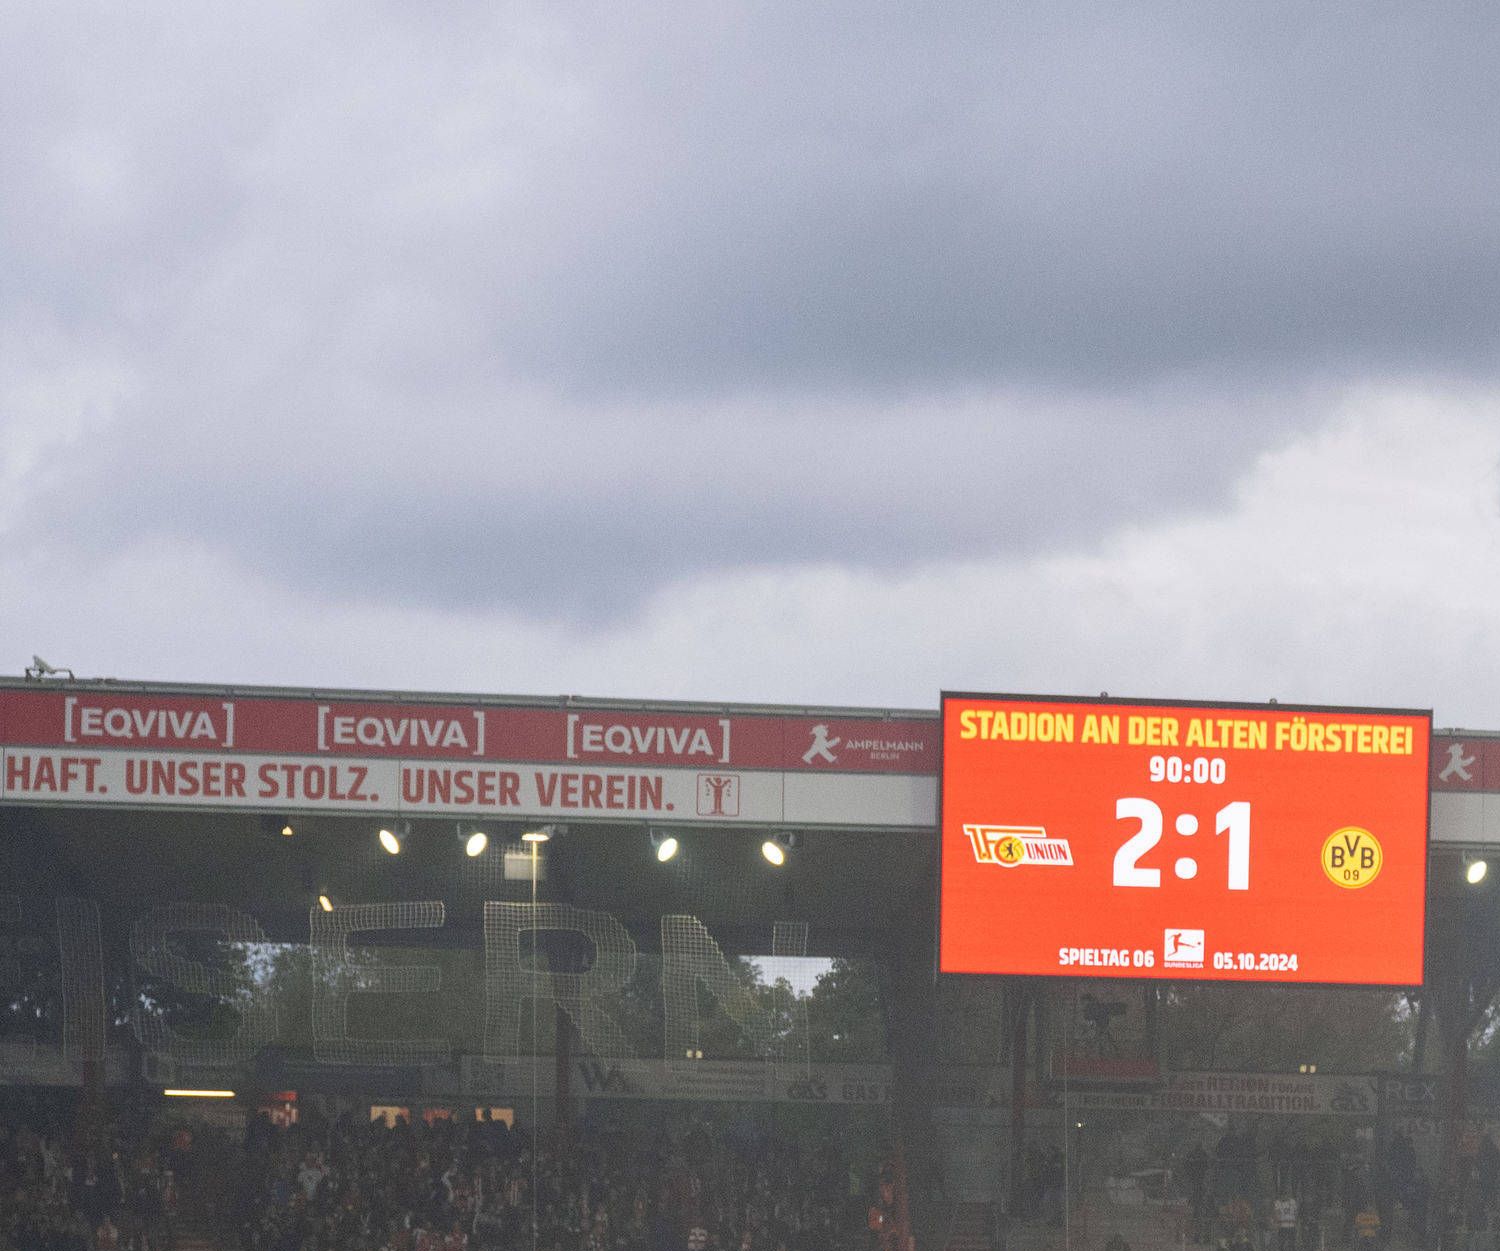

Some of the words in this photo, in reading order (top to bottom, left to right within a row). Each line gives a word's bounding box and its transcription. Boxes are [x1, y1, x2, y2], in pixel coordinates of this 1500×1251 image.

[845, 739, 924, 752] AMPELMANN
[960, 709, 1075, 744] STADION
[1082, 714, 1120, 745] AN
[1128, 716, 1179, 748] DER
[1185, 718, 1268, 751] ALTEN
[1275, 716, 1413, 756] FÖRSTEREI
[1149, 755, 1226, 785] 90:00
[6, 756, 108, 793] HAFT.
[125, 759, 246, 798] UNSER
[258, 763, 380, 801] STOLZ.
[403, 768, 521, 805] UNSER
[535, 773, 675, 811] VEREIN.
[1026, 840, 1068, 863] UNION
[1112, 797, 1251, 891] 2:1
[1331, 835, 1375, 870] BVB
[1343, 868, 1361, 882] 09
[1059, 948, 1131, 967] SPIELTAG
[1133, 949, 1155, 968] 06
[1213, 951, 1298, 972] 05.10.2024
